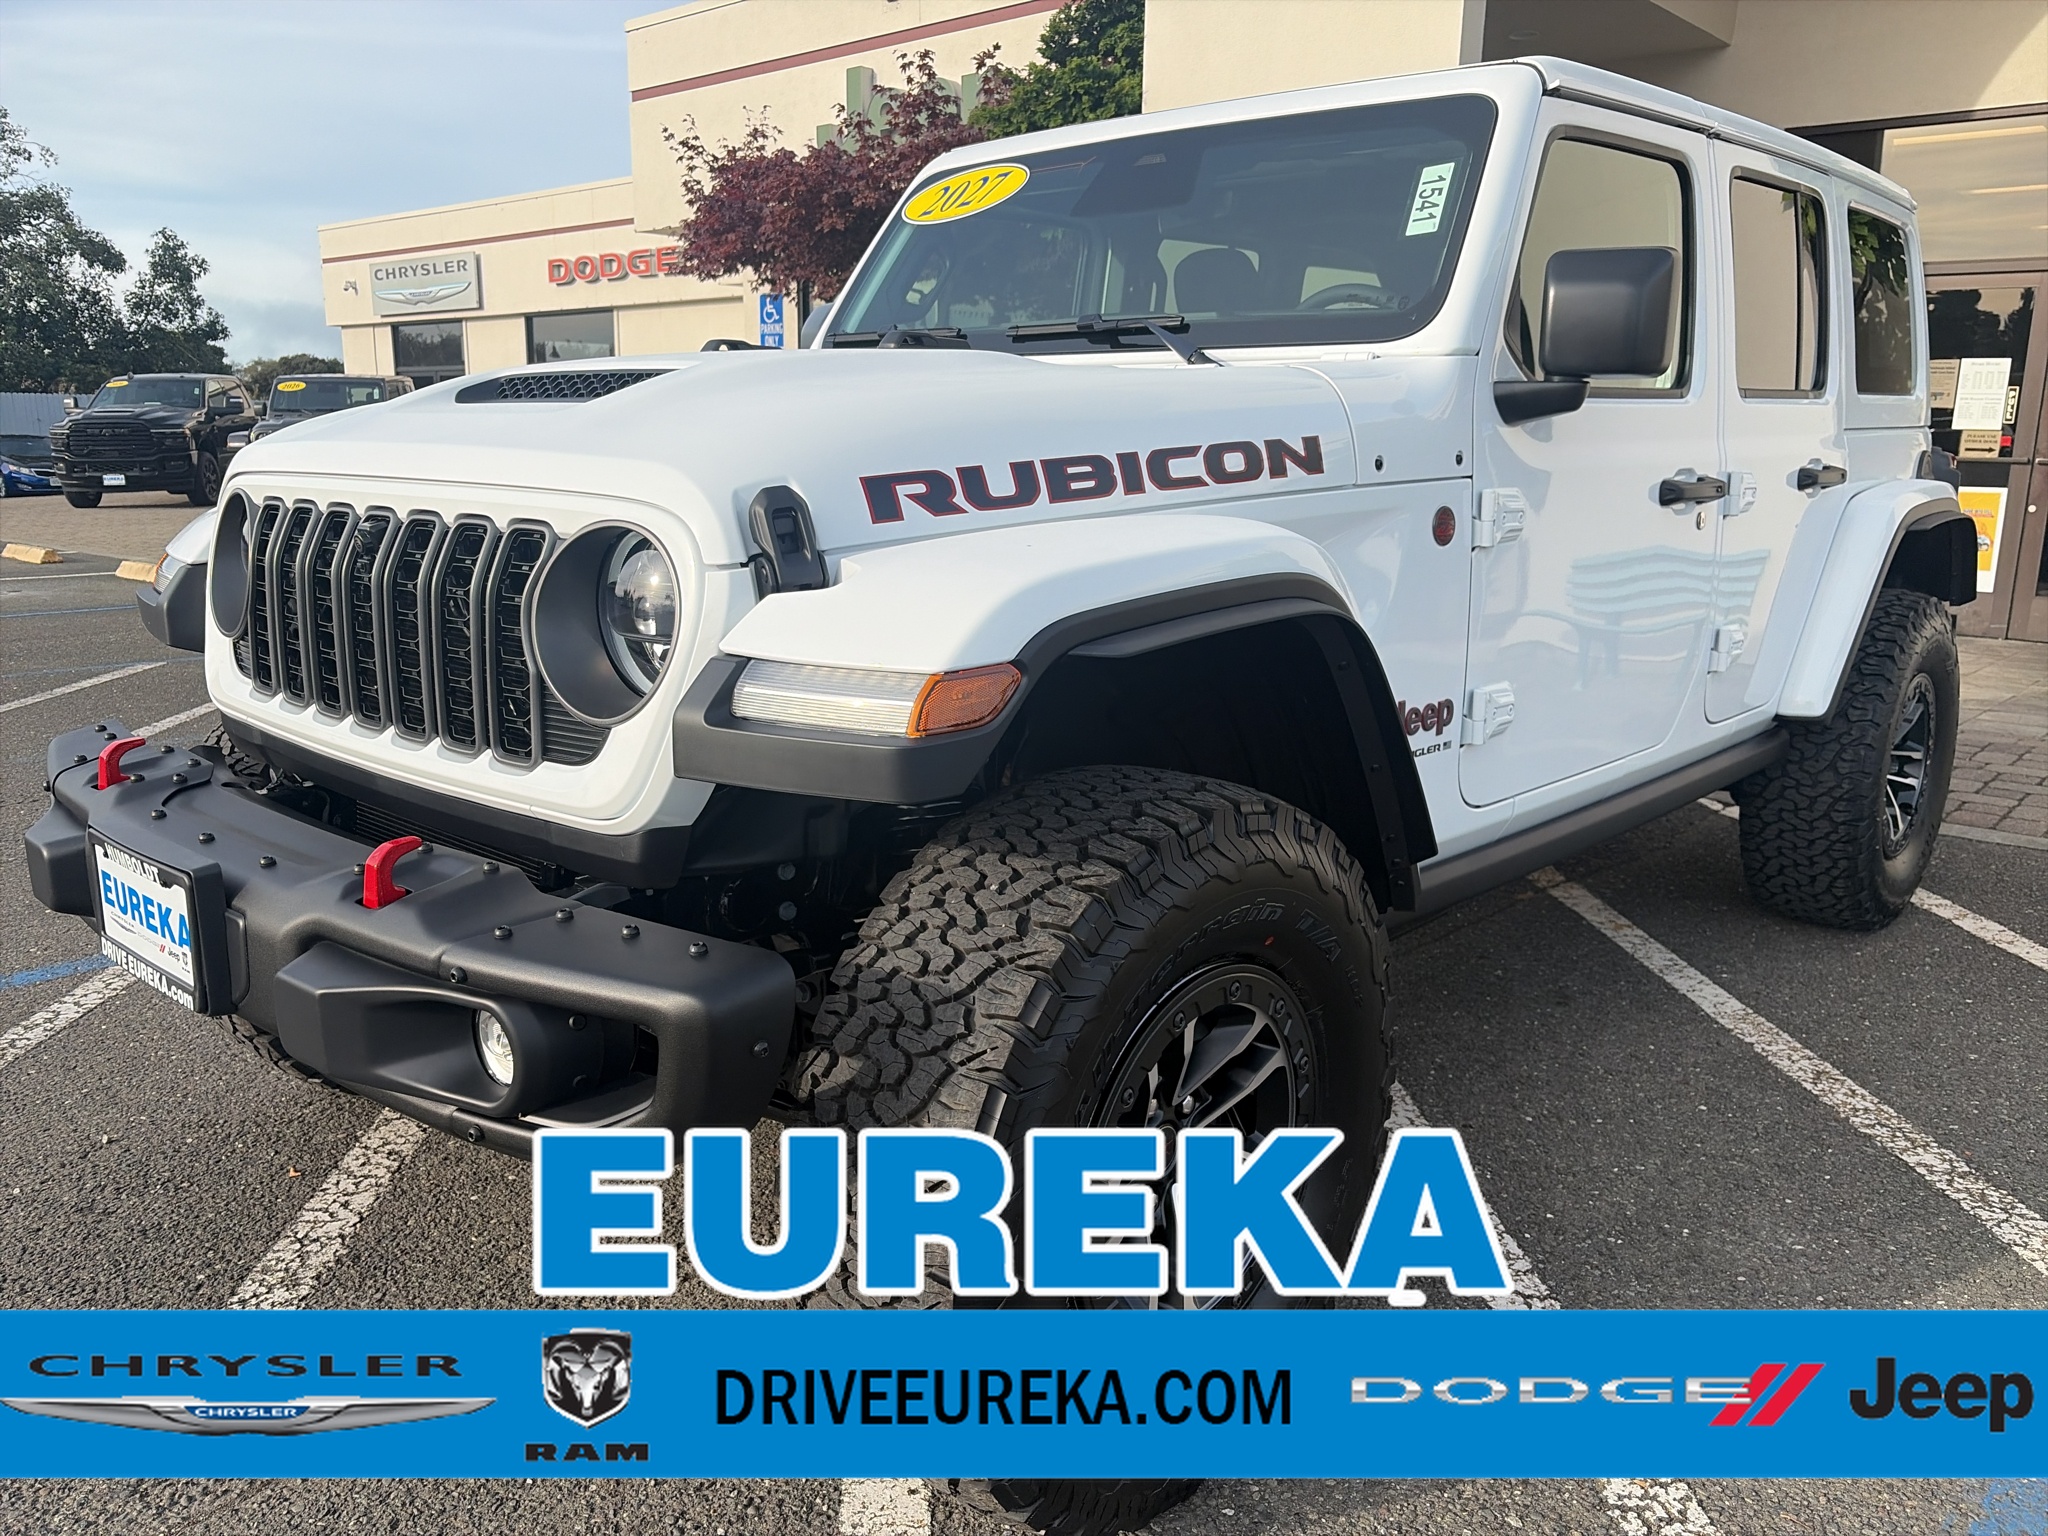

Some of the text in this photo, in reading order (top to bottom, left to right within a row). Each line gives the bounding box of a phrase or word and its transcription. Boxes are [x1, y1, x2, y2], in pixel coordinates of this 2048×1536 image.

[917, 170, 1014, 218] 2027
[1412, 174, 1447, 223] 1541
[373, 258, 469, 282] CHRYSLER
[547, 245, 680, 284] DODGE
[760, 323, 783, 334] PARKING
[2005, 390, 2017, 420] PULL
[859, 434, 1325, 525] RUBICON
[104, 842, 160, 885] HUMBOLDT
[100, 869, 191, 952] EUREKA
[101, 936, 128, 971] DRIVE
